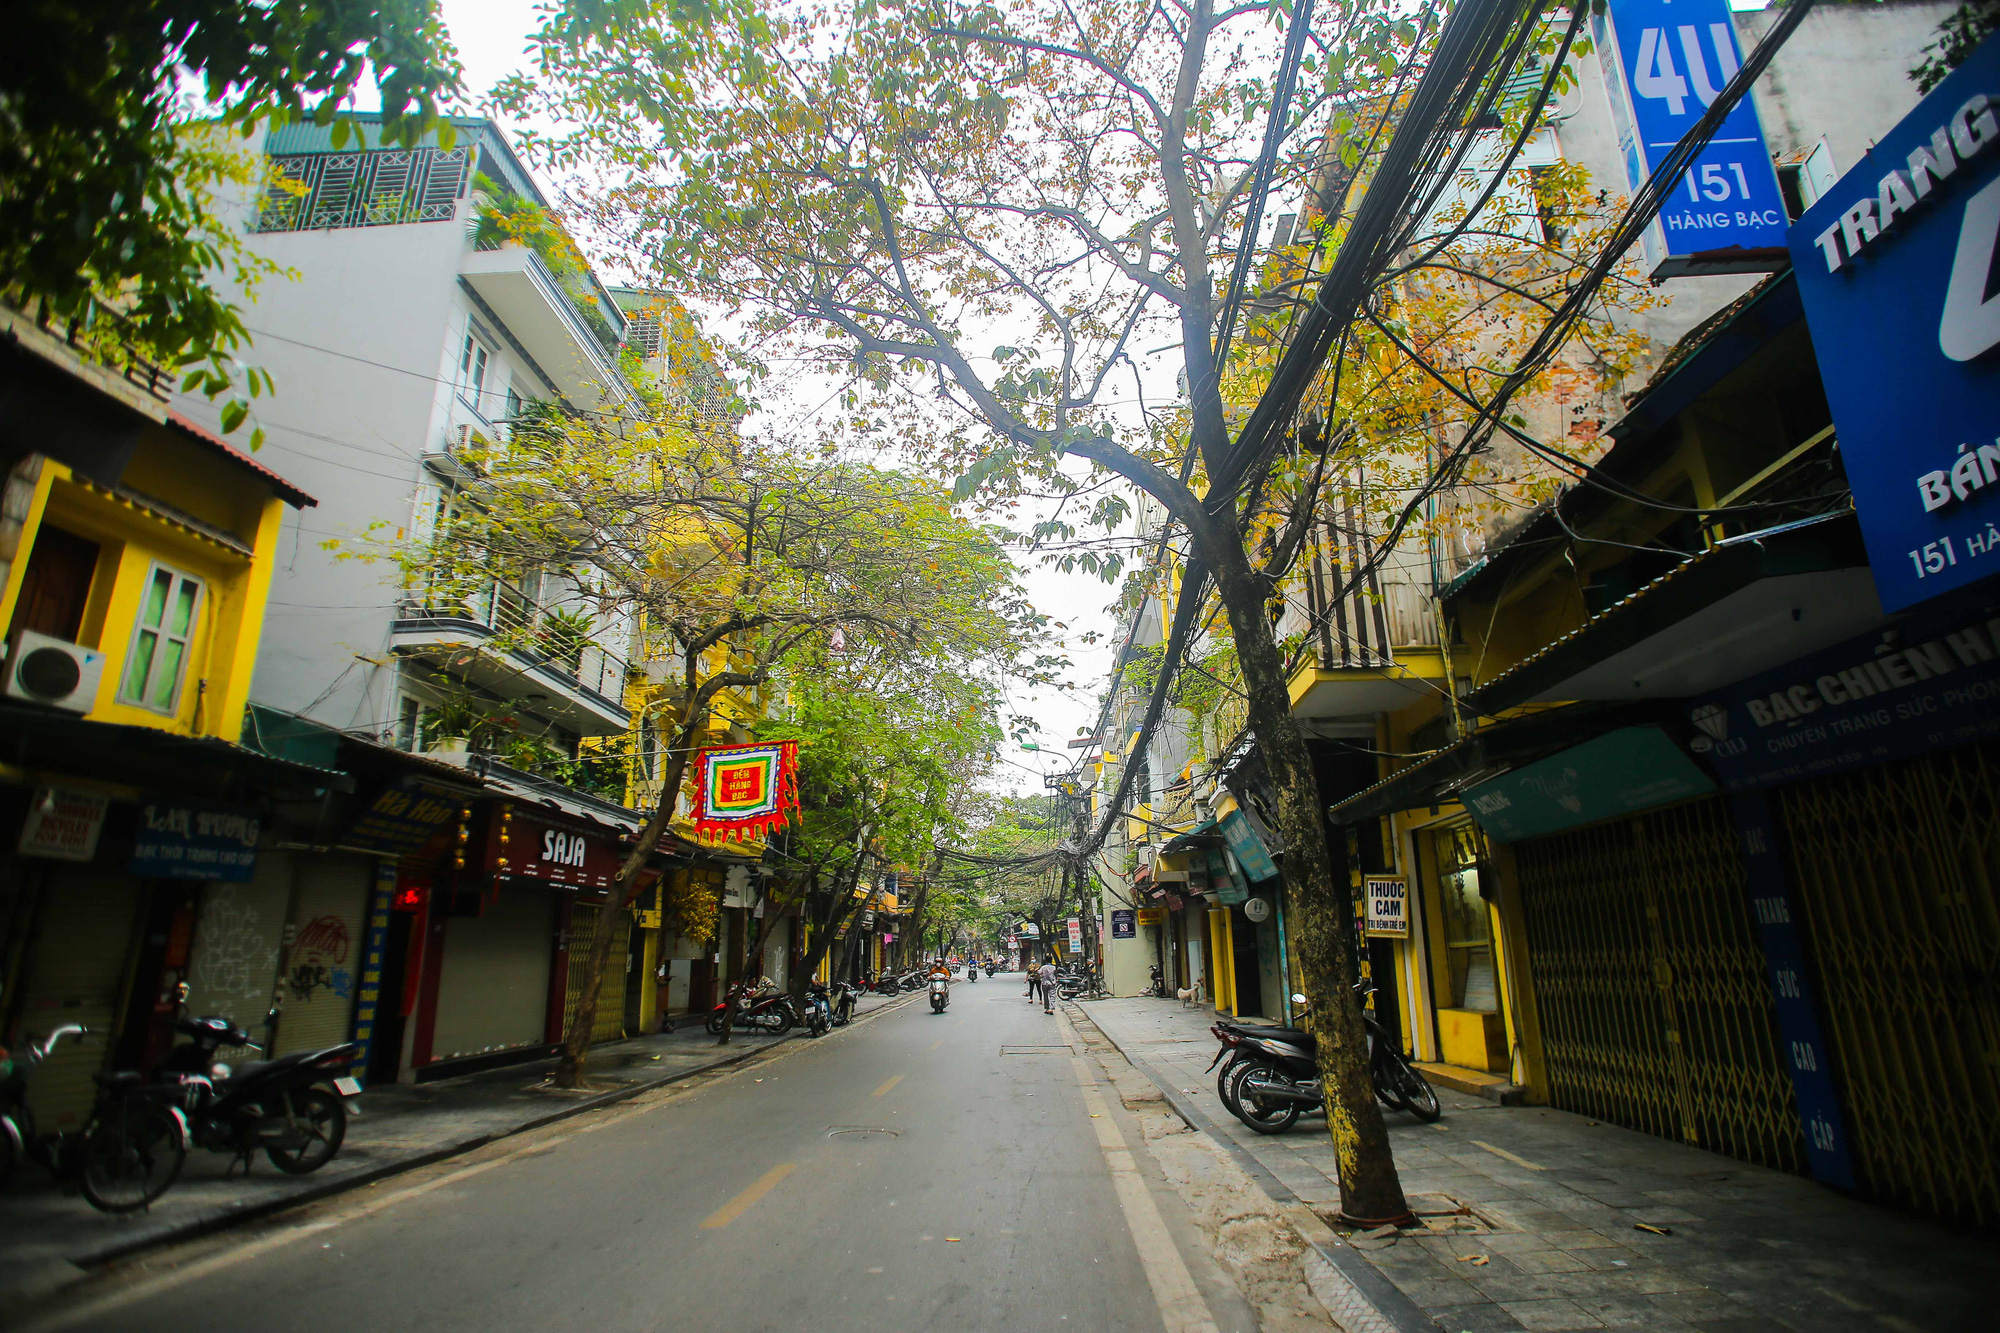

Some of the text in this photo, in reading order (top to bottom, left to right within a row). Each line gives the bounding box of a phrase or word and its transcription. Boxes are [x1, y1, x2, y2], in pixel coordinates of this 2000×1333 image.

[1634, 23, 1742, 116] 4U
[1681, 162, 1751, 203] 151
[1814, 94, 2000, 274] TRANG
[1668, 209, 1780, 231] HÀNG BẠC
[1908, 536, 1957, 579] 151
[1745, 684, 1820, 728] BẠC
[1816, 629, 1950, 706] CHIẾN
[1829, 709, 1892, 737] TRANG
[542, 829, 586, 868] SAJA
[1376, 899, 1401, 916] CAM
[1754, 896, 1791, 923] TRANG
[1792, 1040, 1817, 1072] CAO
